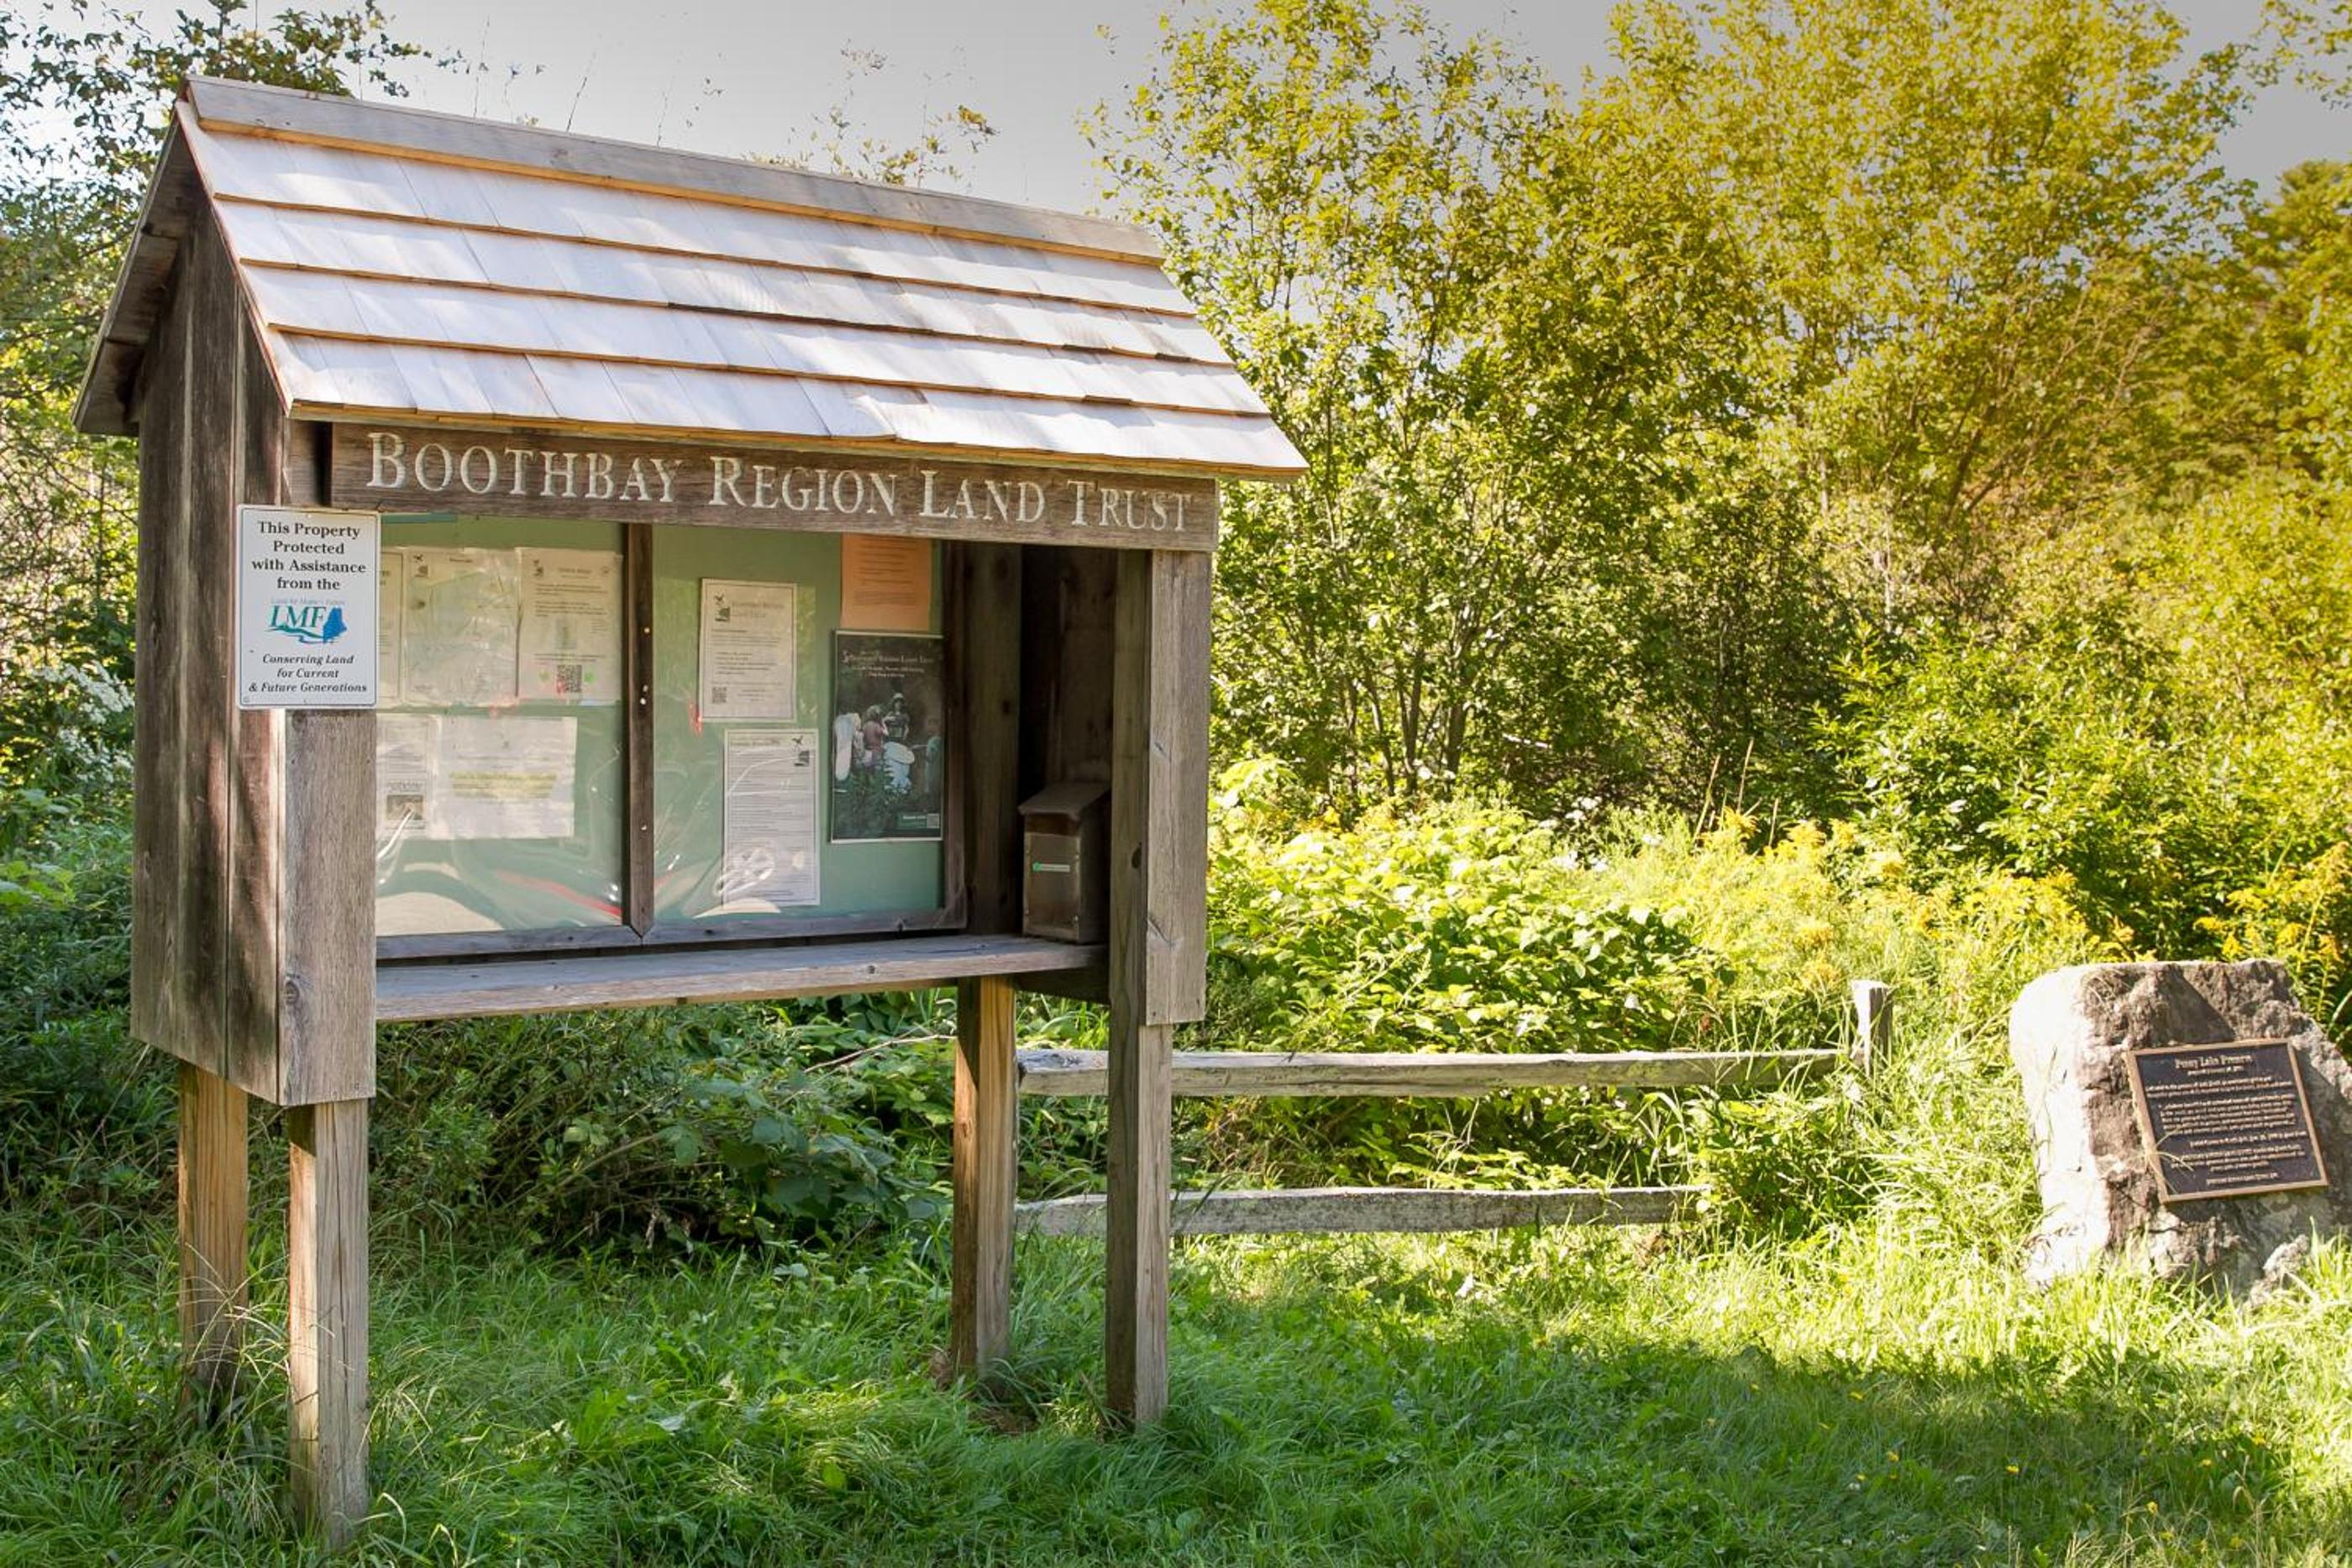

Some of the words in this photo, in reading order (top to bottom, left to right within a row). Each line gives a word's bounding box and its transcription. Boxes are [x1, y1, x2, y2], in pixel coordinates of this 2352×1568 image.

[365, 432, 683, 504] BOOTHBAY
[708, 455, 898, 517] REGION
[918, 469, 1047, 524] LAND
[1066, 479, 1194, 532] TRUST
[257, 520, 290, 534] This
[294, 522, 360, 540] Property
[273, 540, 345, 555] Protected
[251, 558, 285, 571] with
[288, 559, 367, 574] Assistance
[276, 576, 312, 590] from
[317, 578, 341, 590] the
[270, 604, 327, 629] LMF
[262, 653, 323, 666] Conserving
[325, 654, 354, 664] Land
[276, 668, 292, 679] for
[296, 668, 339, 679] Current
[249, 682, 258, 693] &
[260, 682, 298, 693] Future
[300, 682, 368, 693] Generations
